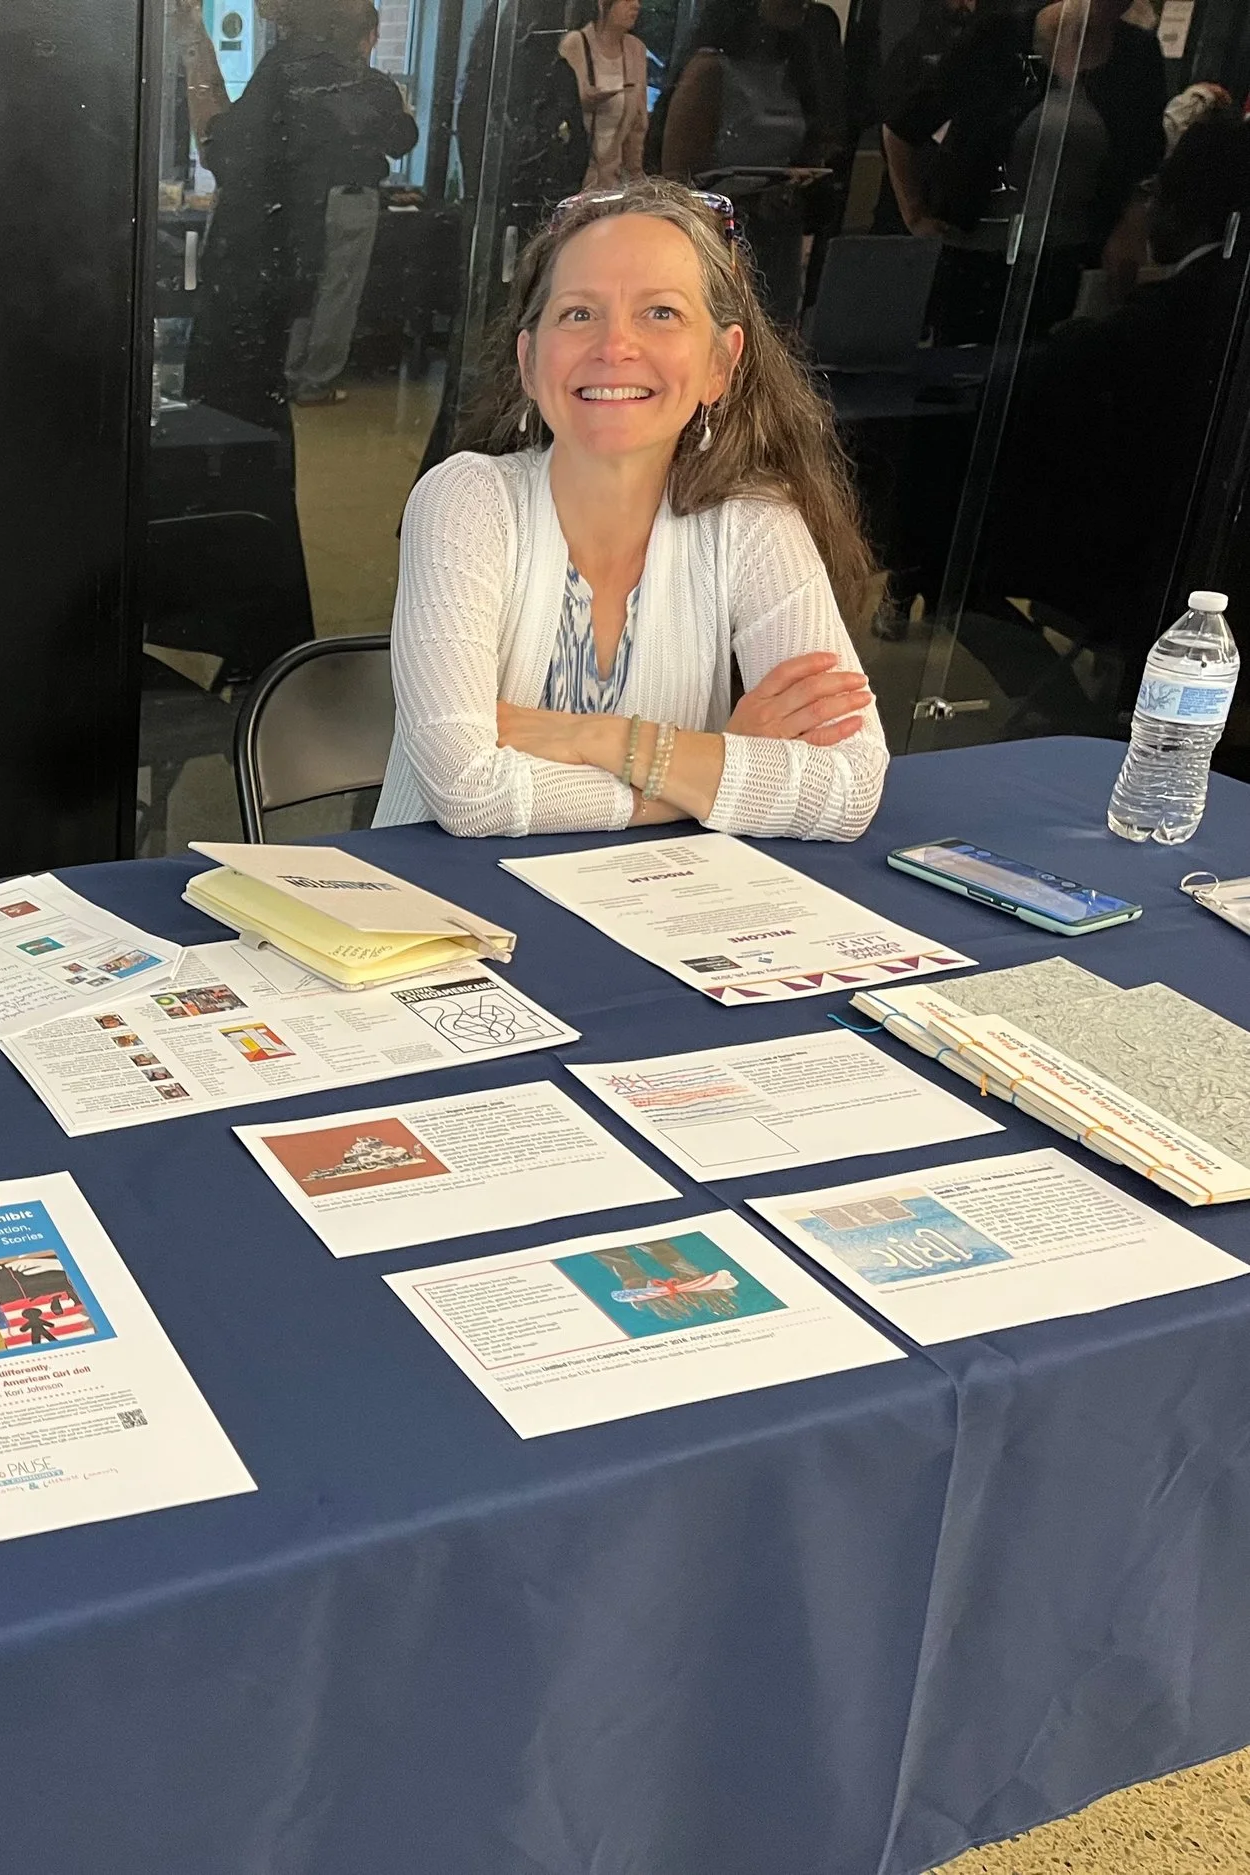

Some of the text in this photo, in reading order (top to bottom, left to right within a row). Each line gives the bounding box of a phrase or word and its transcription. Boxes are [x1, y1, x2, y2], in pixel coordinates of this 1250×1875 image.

[628, 871, 694, 883] PROGRAM
[728, 930, 795, 943] WELCOME
[398, 981, 498, 1002] LATINOAMERICANO
[987, 1031, 1018, 1050] Place
[1031, 1060, 1074, 1085] People
[1071, 1087, 1089, 1095] of
[1090, 1097, 1136, 1125] Stories
[1173, 1140, 1214, 1166] Community
[1, 1233, 43, 1245] Stories
[3, 1375, 50, 1387] American
[52, 1370, 70, 1378] Girl
[73, 1366, 91, 1374] doll
[4, 1388, 24, 1397] Kori
[27, 1383, 63, 1393] Johnson
[7, 1456, 55, 1476] PAUSE
